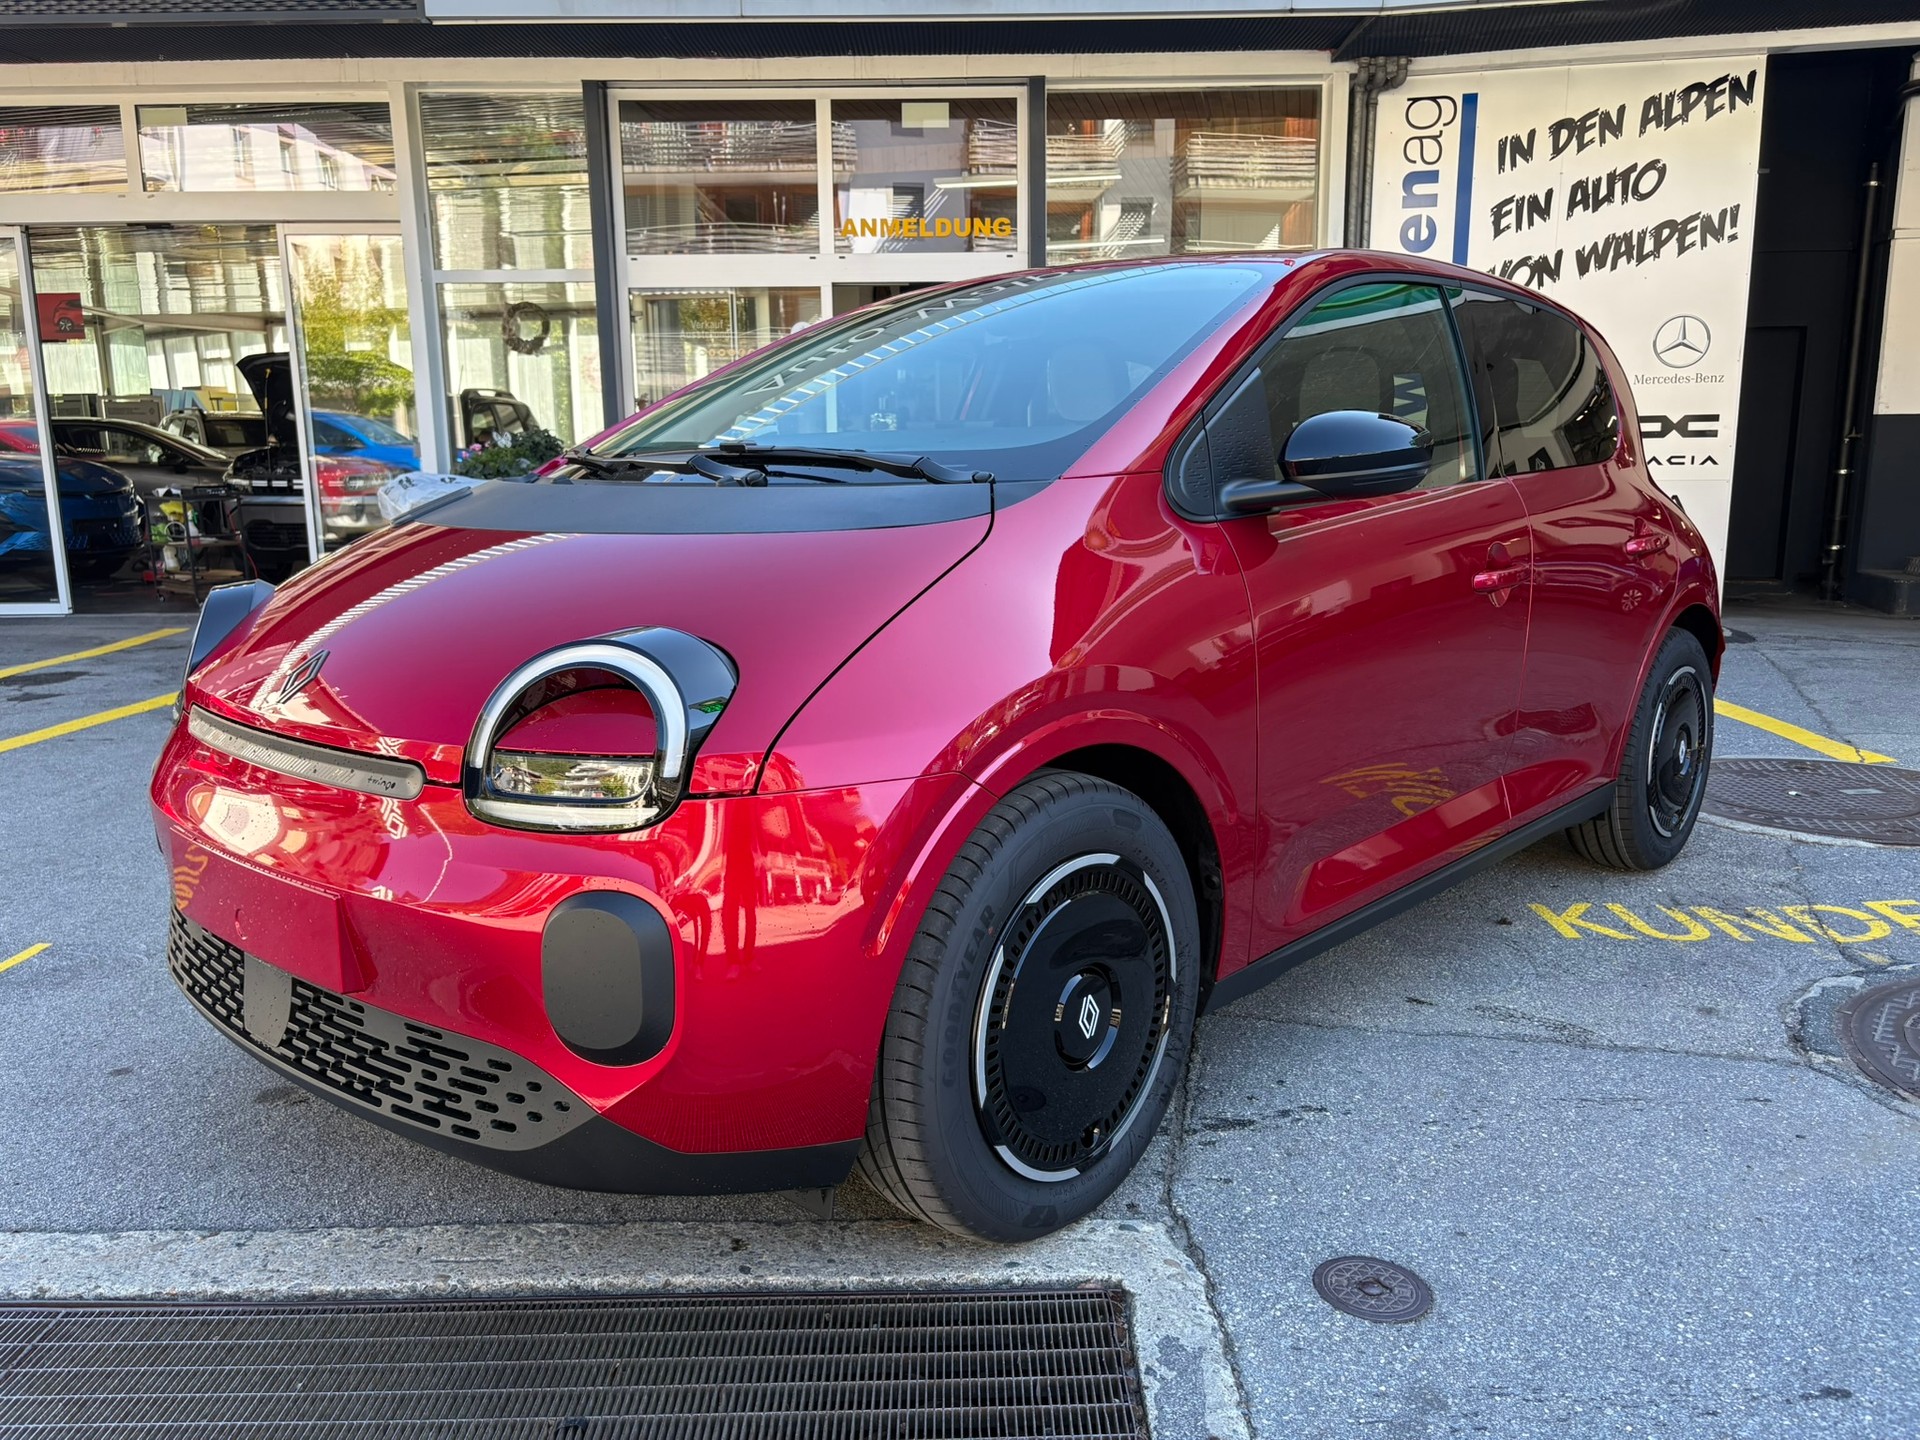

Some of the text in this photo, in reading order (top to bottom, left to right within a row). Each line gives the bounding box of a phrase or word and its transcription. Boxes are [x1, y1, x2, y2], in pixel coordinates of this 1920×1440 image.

[1497, 69, 1757, 175] IN DEN ALPEN
[1489, 158, 1668, 241] EIN AUTO
[840, 217, 1012, 238] ANMELDUNG
[1575, 203, 1741, 280] WALPEN!
[1632, 373, 1726, 386] Mercedes-Benz
[1646, 454, 1720, 466] ACIA
